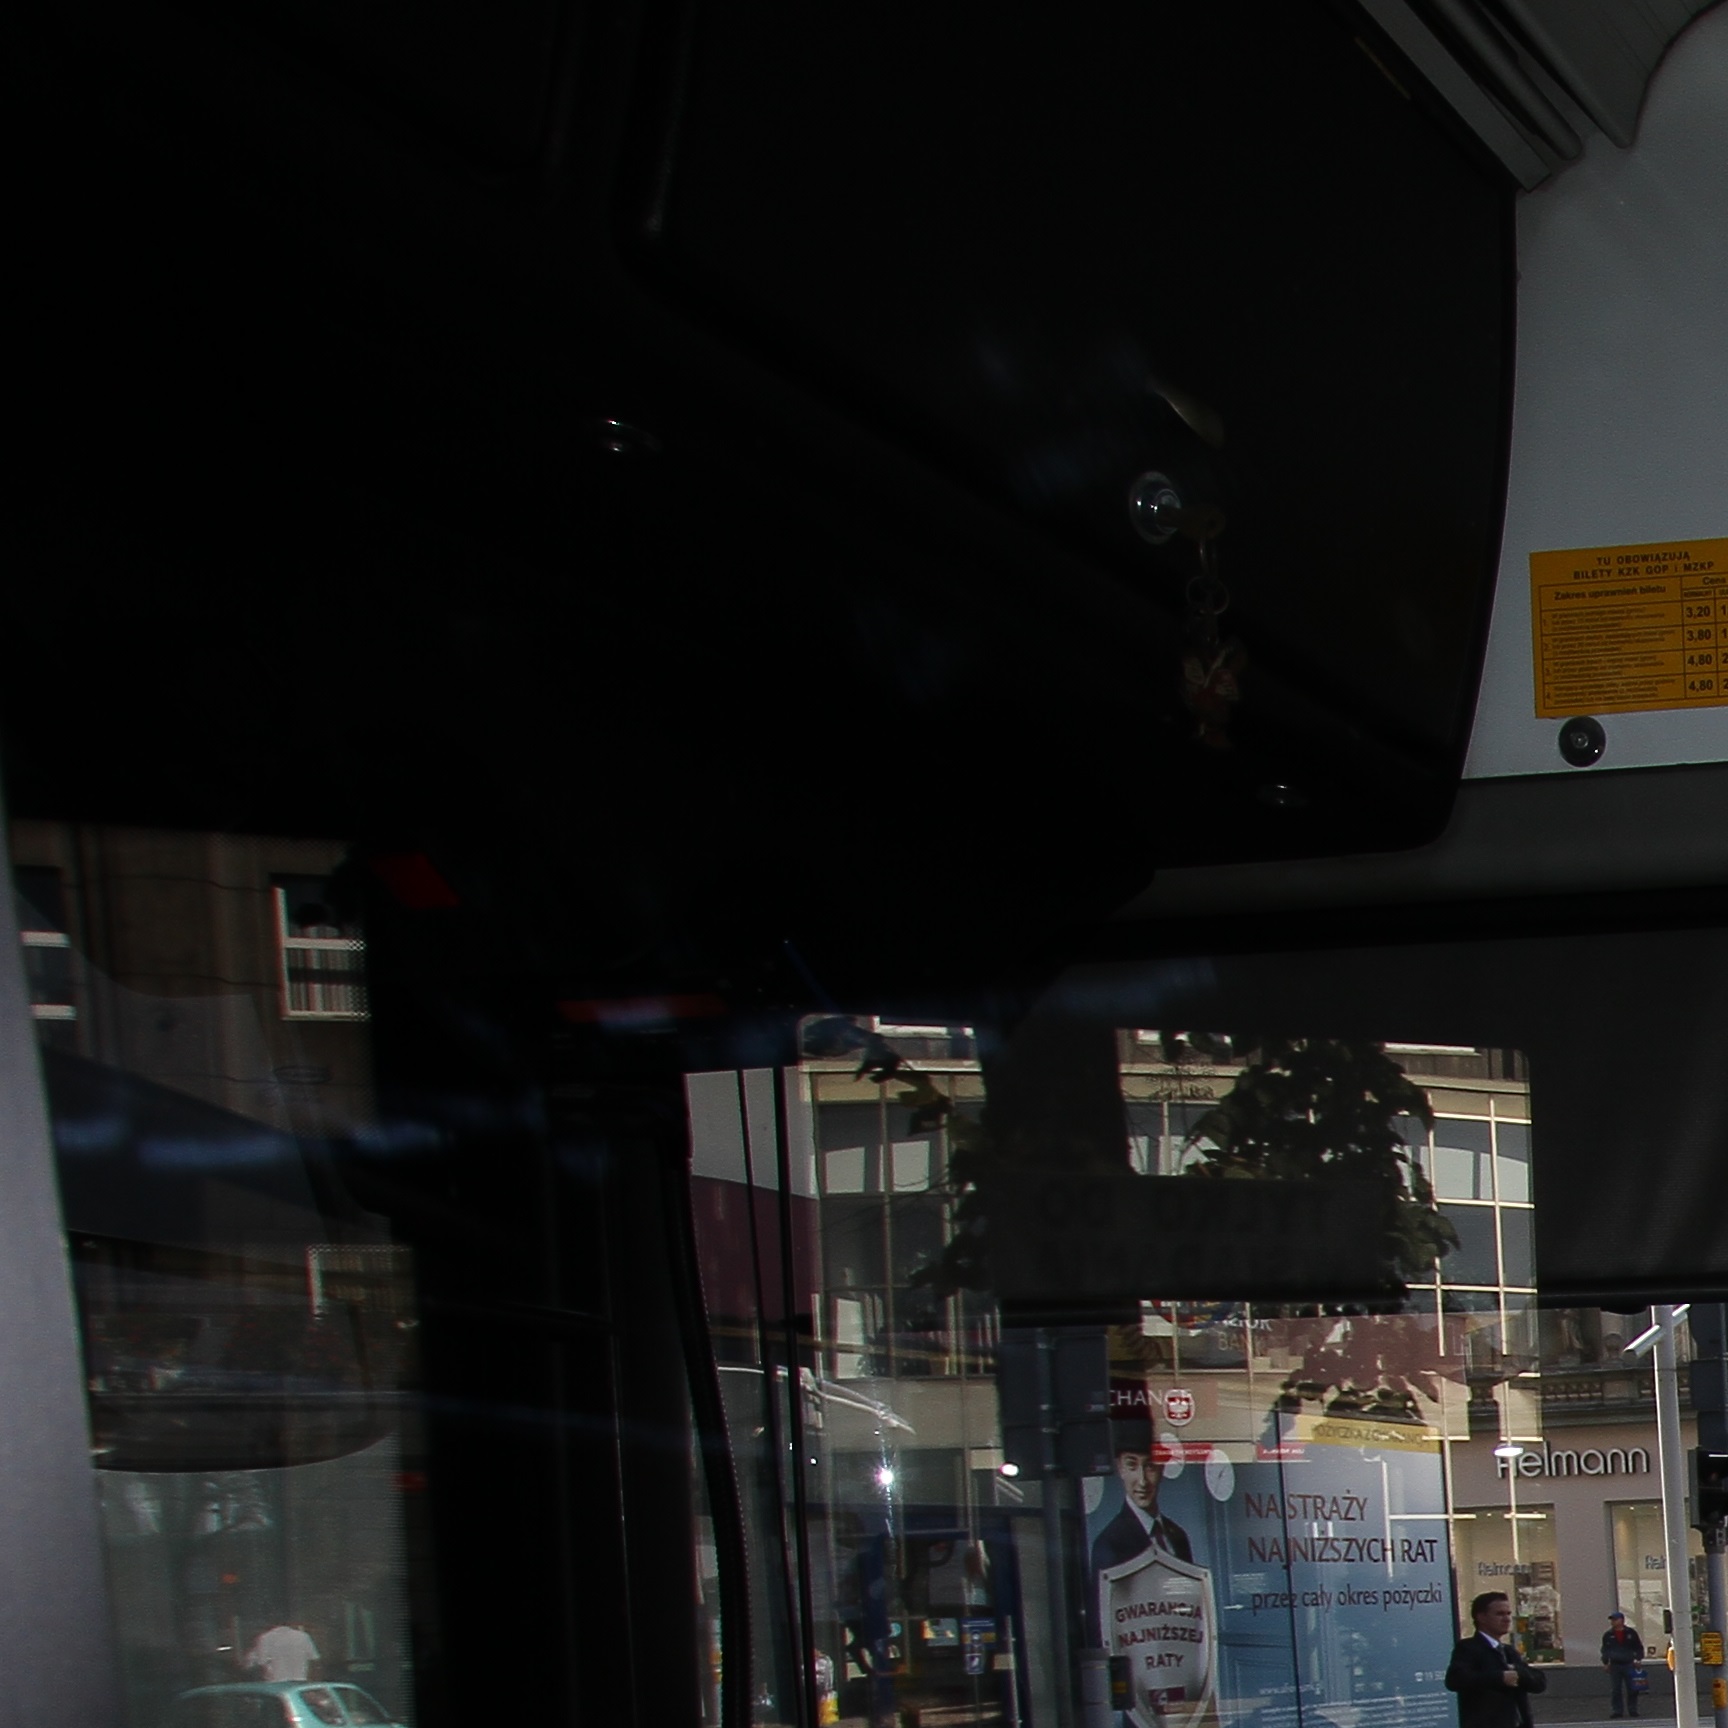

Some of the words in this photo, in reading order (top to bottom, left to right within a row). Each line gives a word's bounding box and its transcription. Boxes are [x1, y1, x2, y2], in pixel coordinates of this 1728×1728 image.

[1597, 556, 1611, 566] TU
[1616, 550, 1690, 564] OBOWIĄZUJĄ
[1573, 568, 1612, 580] BILETY
[1618, 566, 1639, 576] KZK
[1645, 564, 1669, 575] GOP
[1683, 561, 1714, 572] MZKP
[1702, 576, 1727, 585] Cena
[1554, 589, 1586, 601] Zakres
[1588, 586, 1638, 600] uprawnień
[1639, 584, 1667, 595] biletu
[1686, 606, 1711, 618] 3,20
[1687, 629, 1712, 640] 3,80
[1687, 654, 1713, 666] 4,80
[1688, 679, 1714, 691] 4,80
[1245, 1493, 1282, 1519] NA
[1287, 1489, 1368, 1521] STRAŻY
[1401, 1539, 1438, 1563] RAT
[1302, 1584, 1333, 1613] cały
[1337, 1584, 1379, 1606] okres
[1383, 1583, 1442, 1610] pożyczki
[1115, 1601, 1203, 1623] GWARANCJA
[1119, 1624, 1204, 1646] NAJNIŻSZEJ
[1145, 1653, 1185, 1670] RATY
